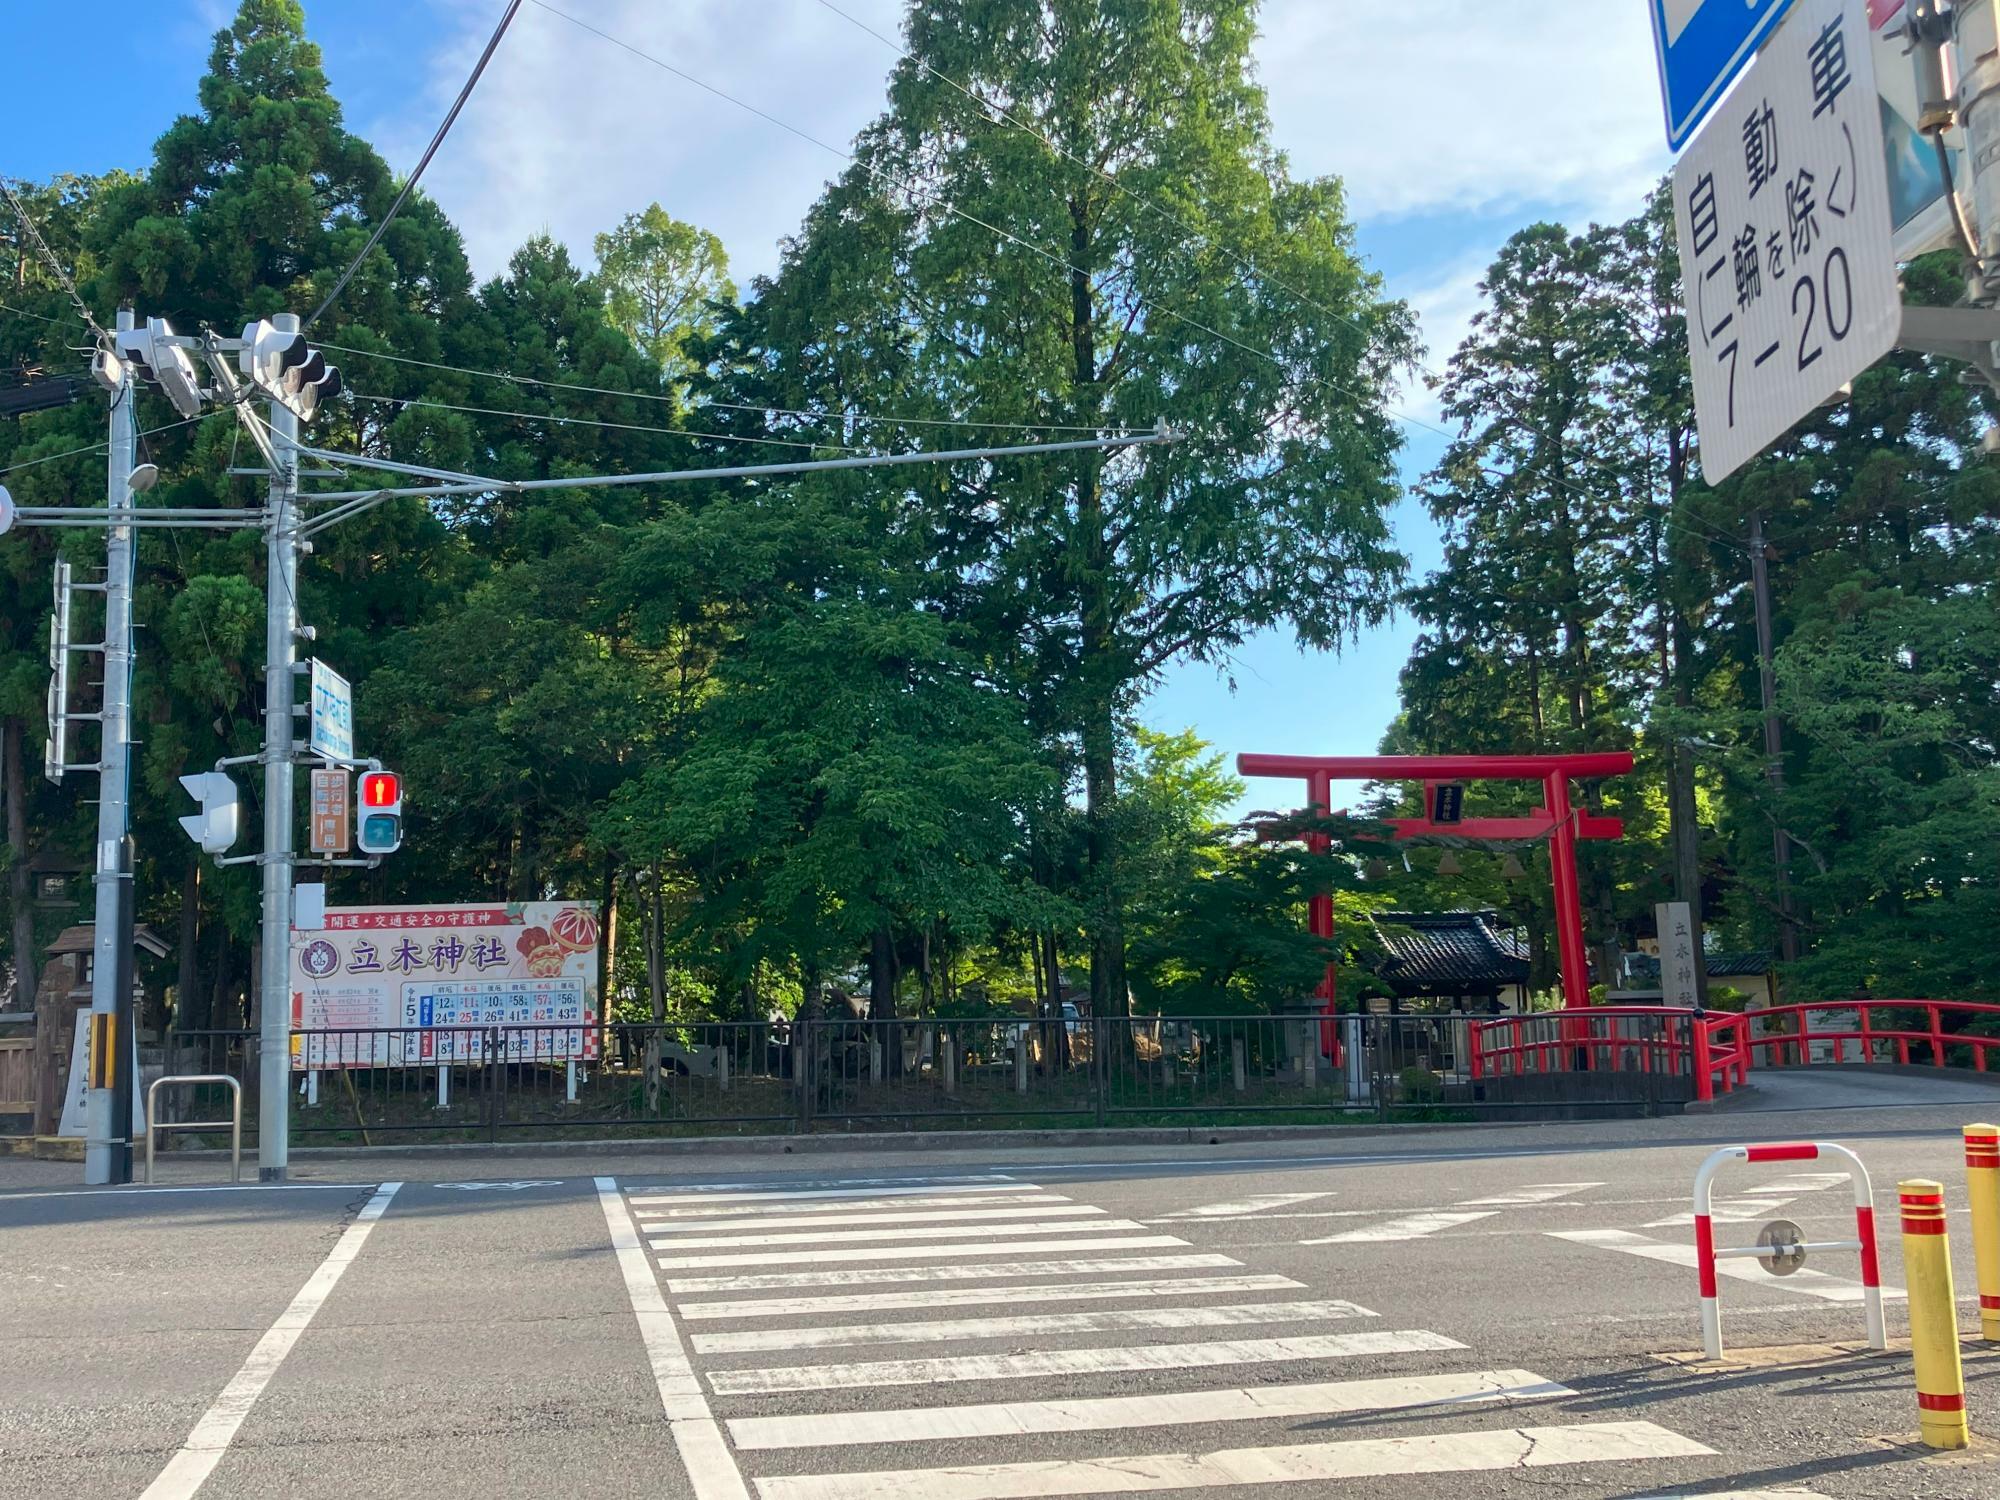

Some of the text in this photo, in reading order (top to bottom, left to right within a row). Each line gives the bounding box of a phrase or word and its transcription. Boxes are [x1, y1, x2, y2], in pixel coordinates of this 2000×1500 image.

[1689, 12, 1852, 258] 自動車
[1698, 121, 1857, 348] (二輪を除く)
[347, 935, 507, 973] 立木神社
[1675, 922, 1694, 1006] 立木神社
[435, 1013, 448, 1024] 24
[459, 1012, 472, 1023] 25
[484, 1010, 497, 1022] 26
[509, 1010, 520, 1022] 41
[533, 1009, 545, 1021] 42
[558, 1008, 570, 1020] 43
[440, 998, 450, 1008] 12
[489, 996, 499, 1007] 10
[513, 995, 524, 1006] 58
[537, 994, 548, 1006] 57
[561, 993, 573, 1005] 56
